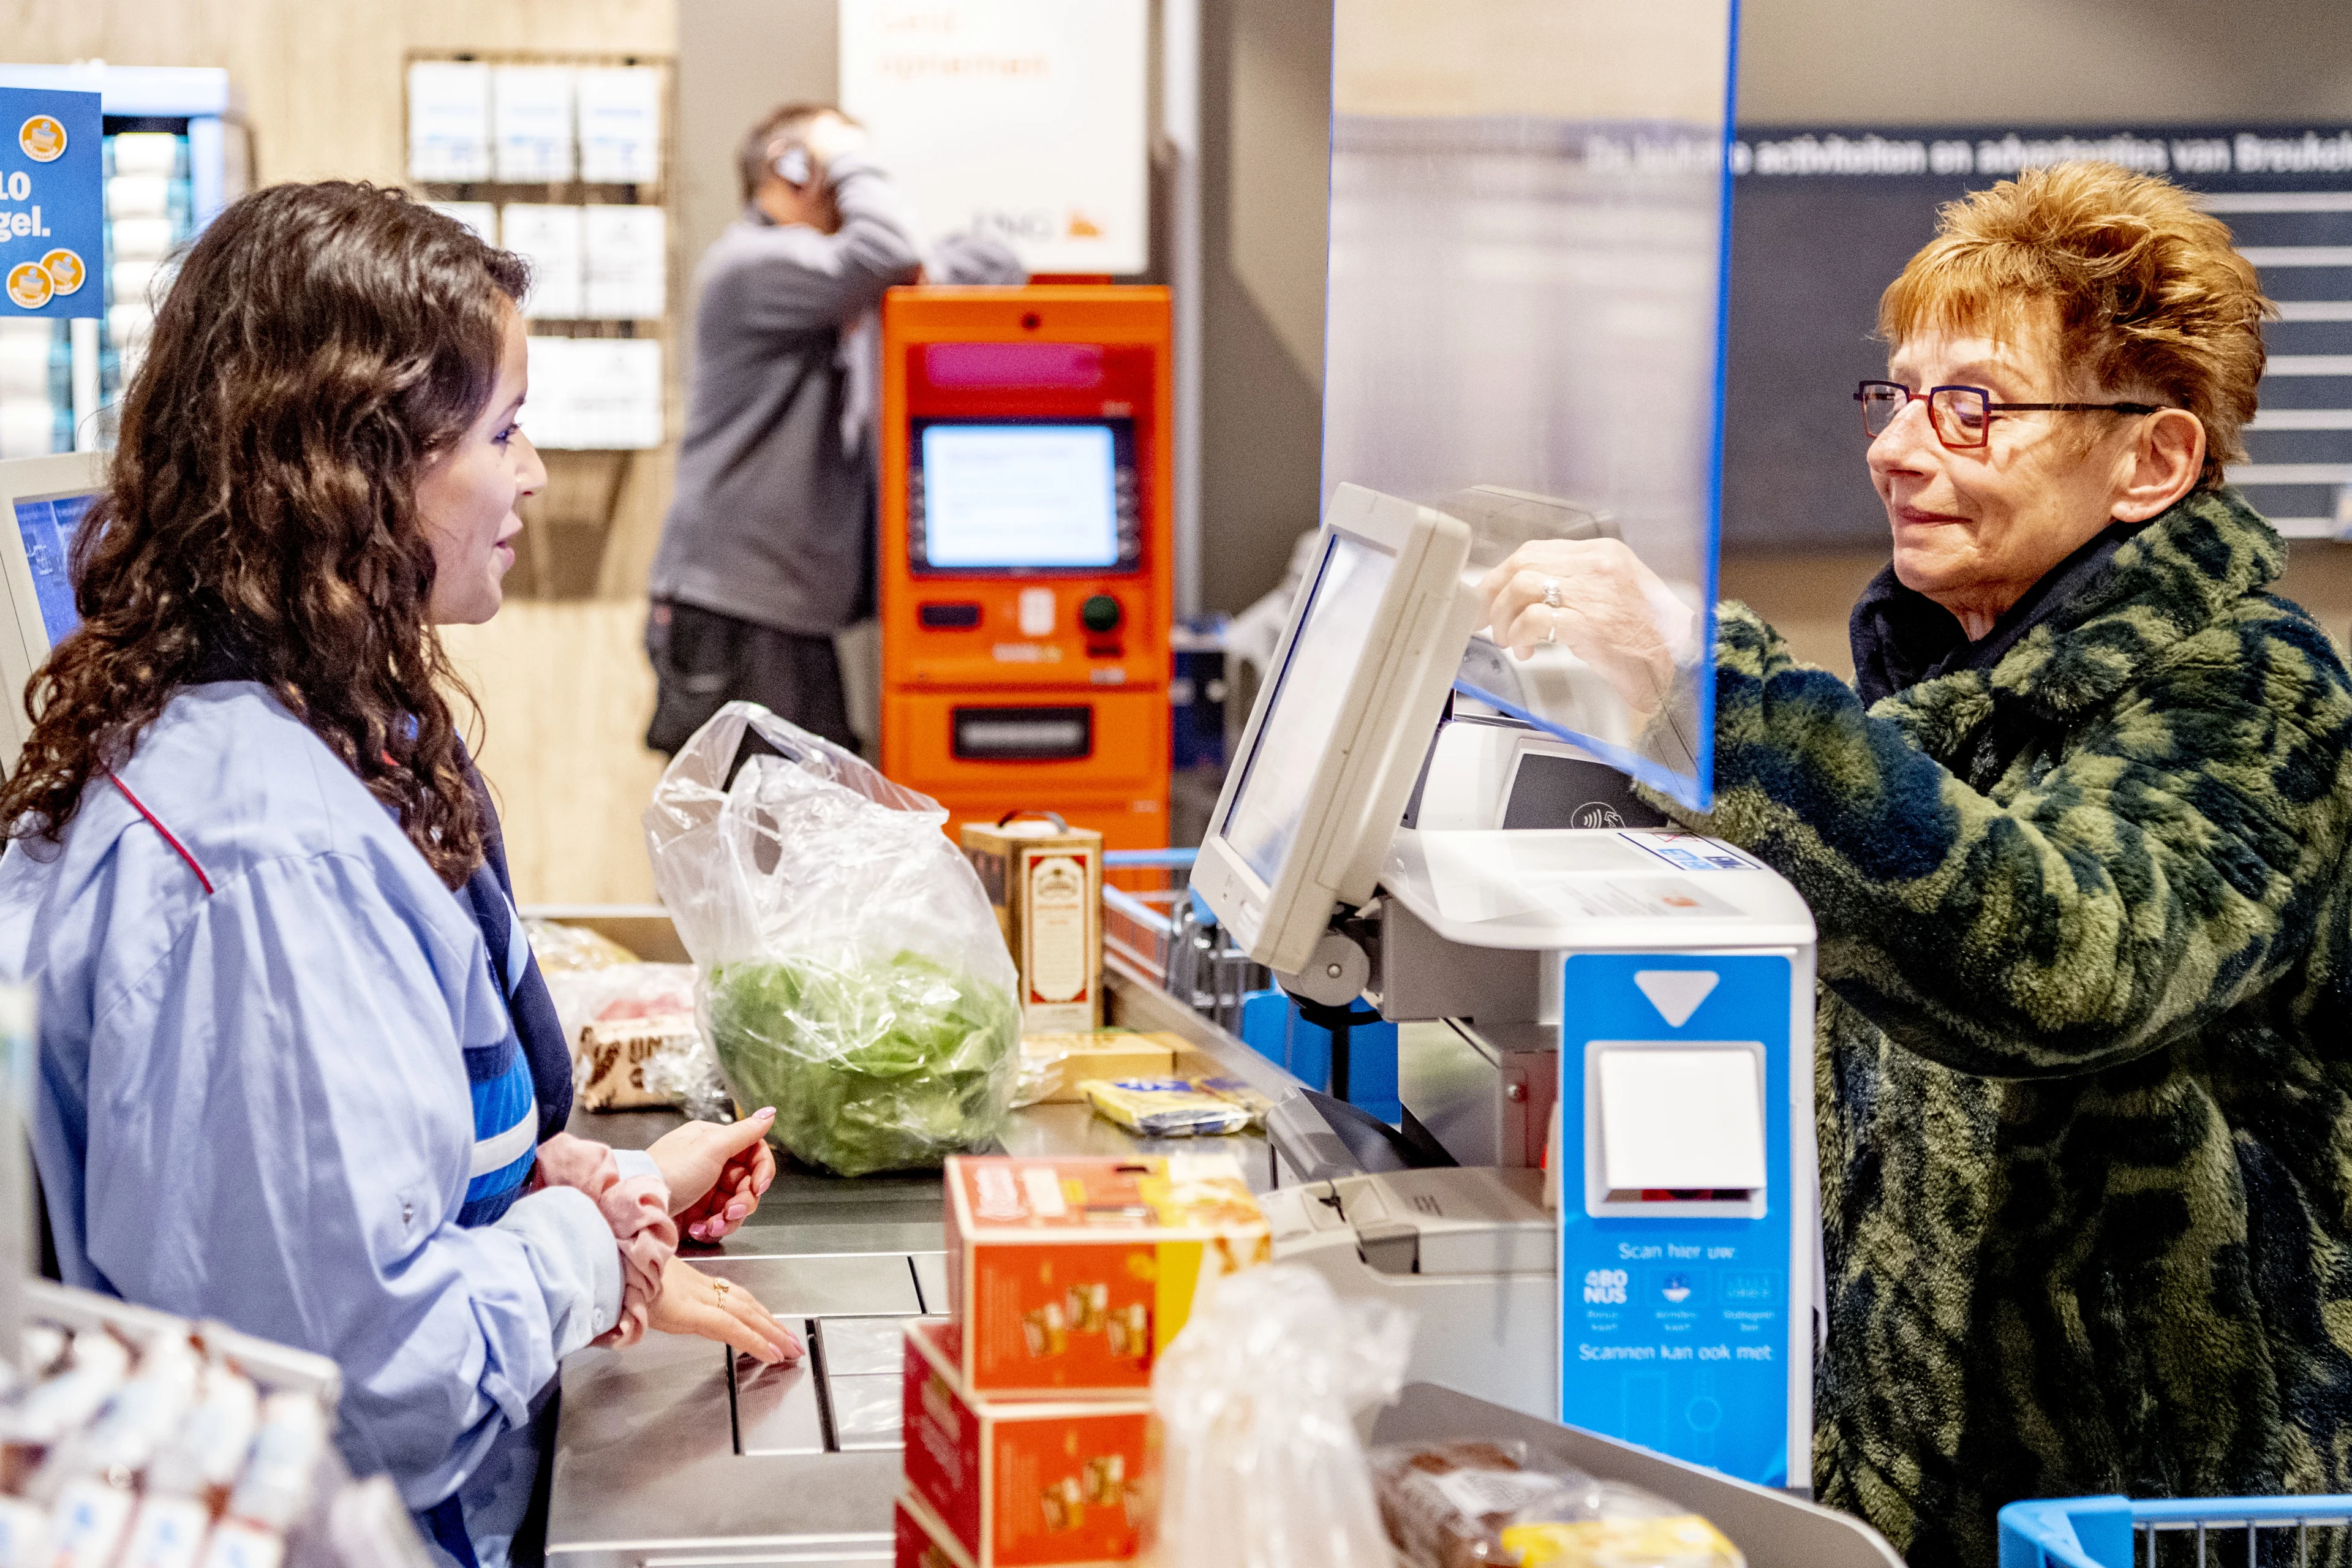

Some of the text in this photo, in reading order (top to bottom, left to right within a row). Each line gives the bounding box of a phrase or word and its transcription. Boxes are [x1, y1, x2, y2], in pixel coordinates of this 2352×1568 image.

[1754, 133, 1928, 175] activiteiten
[1929, 140, 1973, 175] en
[2170, 138, 2231, 173] van
[1618, 1242, 1663, 1259] Scan
[1668, 1243, 1701, 1259] hier
[1583, 1286, 1627, 1304] NUS
[1578, 1344, 1773, 1360] Scannen kan ook met
